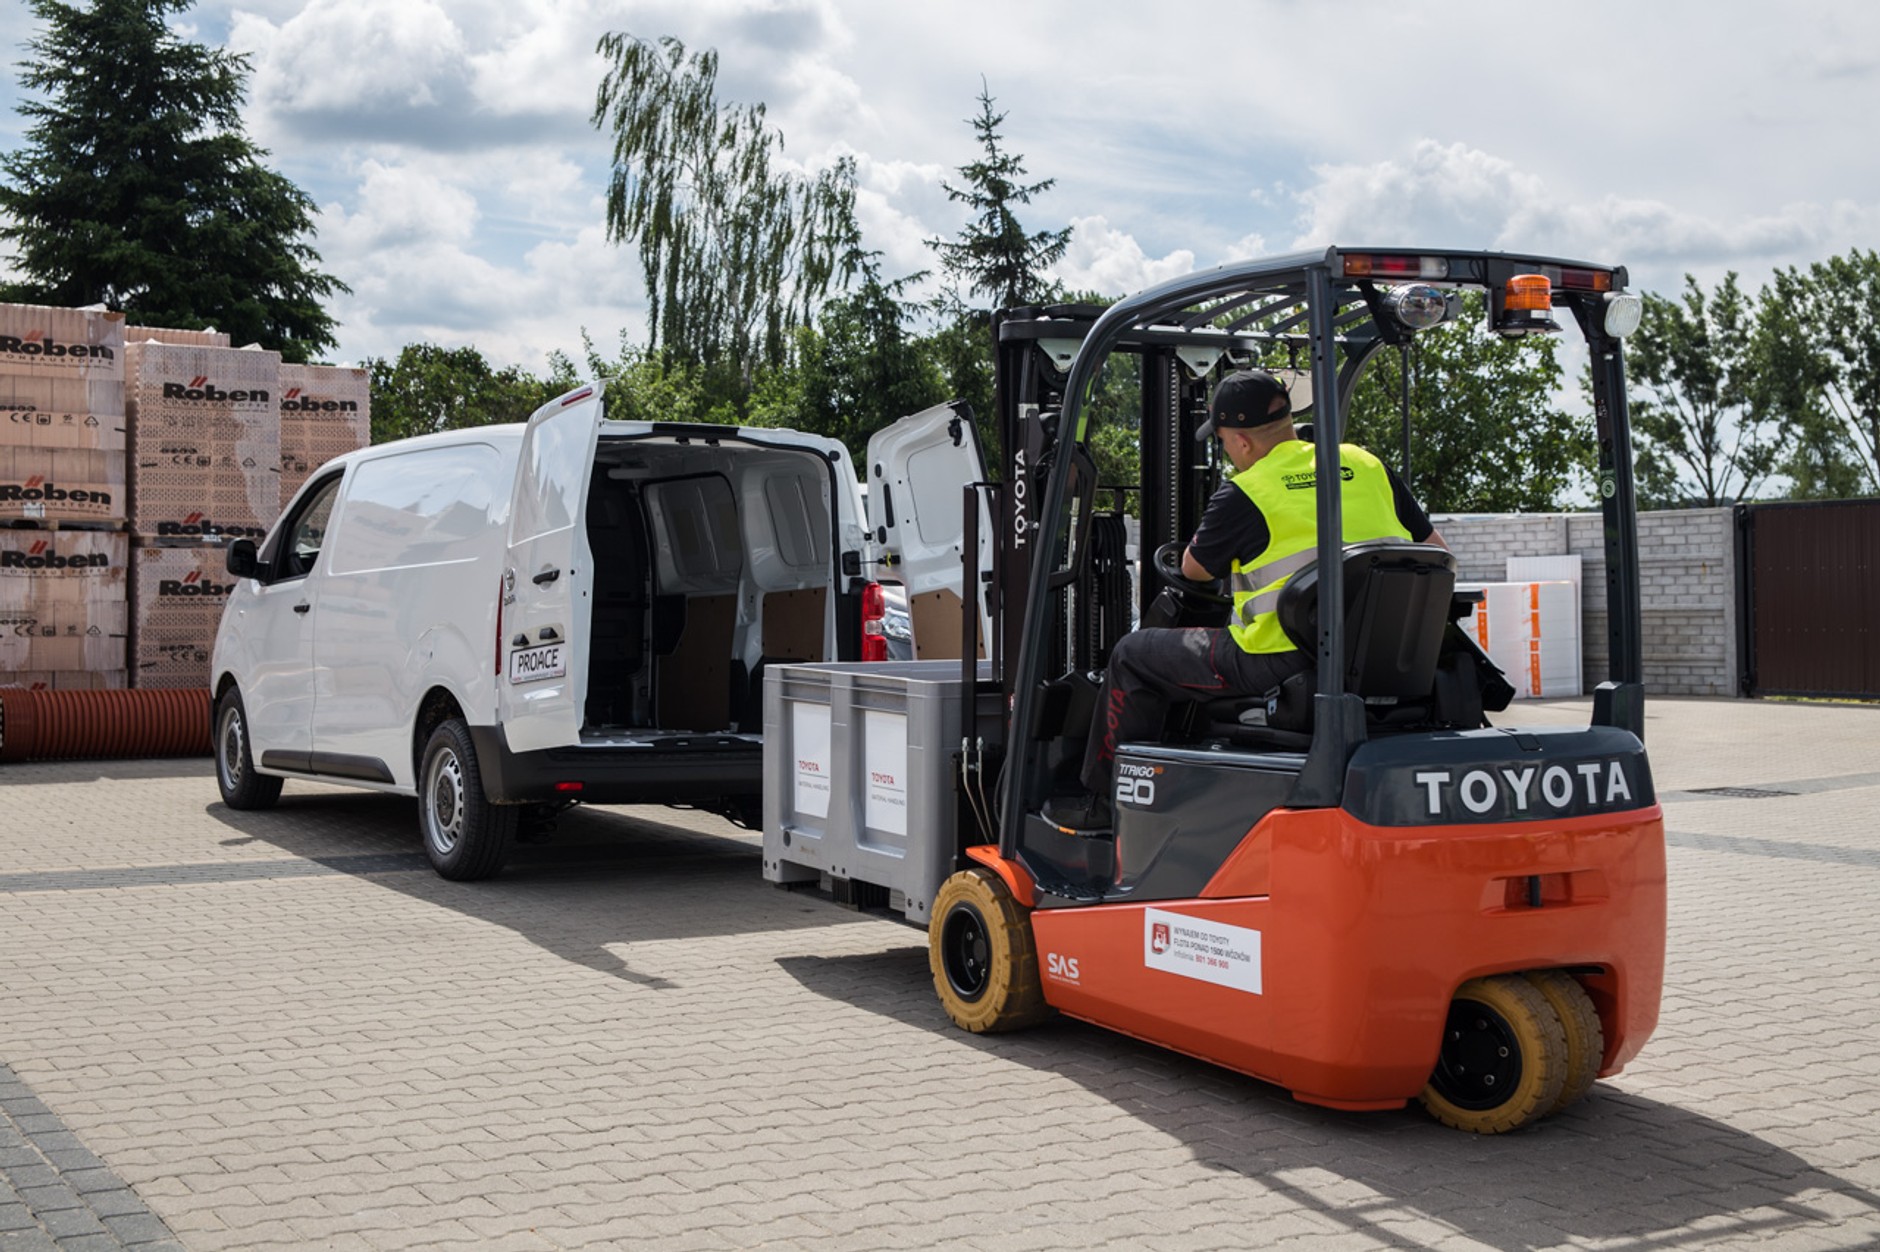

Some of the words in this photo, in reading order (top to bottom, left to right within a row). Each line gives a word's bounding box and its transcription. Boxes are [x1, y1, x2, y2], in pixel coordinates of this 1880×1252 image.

[163, 376, 269, 402] Röben
[280, 388, 357, 412] öben
[1015, 449, 1026, 549] TOYOTA
[1, 539, 109, 568] Röben
[517, 648, 559, 673] PROACE
[798, 760, 820, 772] TOYOTA
[871, 772, 895, 784] TOYOTA
[1116, 776, 1155, 805] 20
[1416, 761, 1632, 814] TOYOTA
[1047, 952, 1079, 979] SAS
